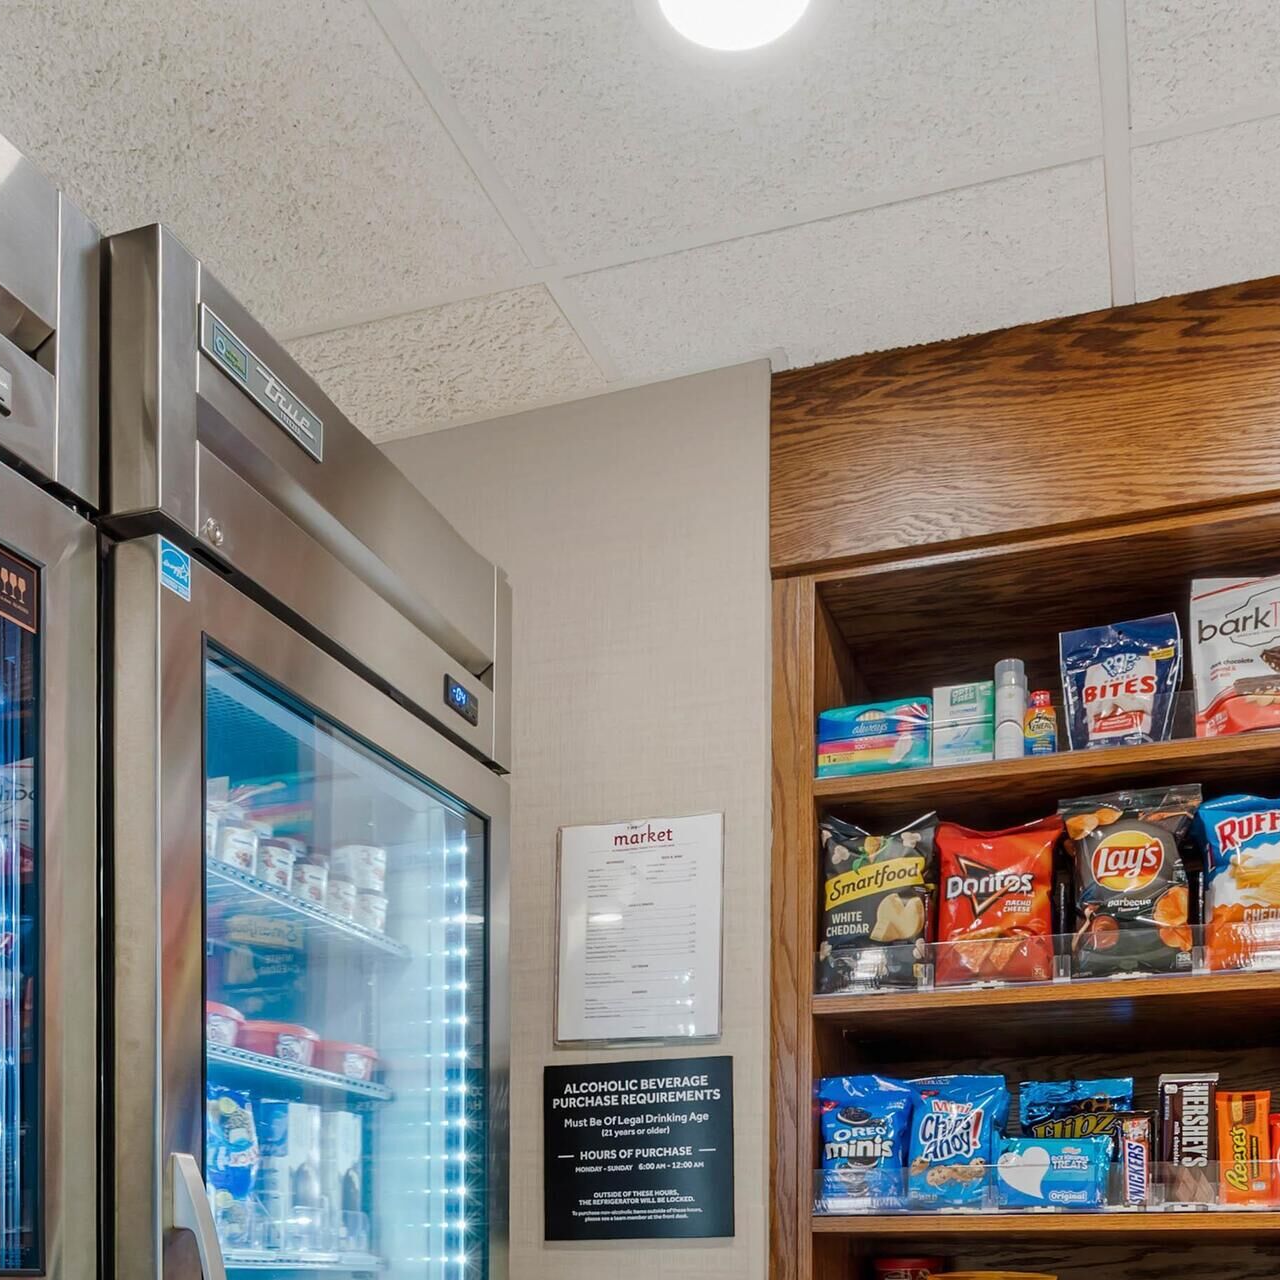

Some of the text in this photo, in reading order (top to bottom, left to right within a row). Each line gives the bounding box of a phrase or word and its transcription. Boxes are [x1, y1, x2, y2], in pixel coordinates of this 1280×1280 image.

[1083, 675, 1157, 704] BITES
[851, 721, 889, 736] always
[613, 824, 674, 847] market
[1096, 844, 1160, 880] Lay's
[829, 862, 919, 902] Smartfood
[945, 872, 1035, 900] Doritos
[1004, 899, 1032, 907] NACHO
[1106, 897, 1152, 908] Barbecue
[831, 910, 863, 924] WHITE
[825, 923, 871, 938] CHEDDAR
[563, 1075, 709, 1095] ALCOHOLIC BEVERAGE
[552, 1088, 721, 1109] PURCHASE REQUIREMENTS
[932, 1098, 974, 1115] Mini
[563, 1111, 710, 1128] Must Be Of Legal Drinking Age
[919, 1112, 972, 1145] Chips
[1033, 1109, 1119, 1139] Flipz
[1181, 1082, 1210, 1168] HERSHEY'S
[601, 1126, 671, 1138] (21 years or older)
[833, 1125, 887, 1142] OREO
[579, 1146, 693, 1161] HOURS OF PURCHASE
[824, 1136, 895, 1161] minis
[575, 1165, 603, 1173] MONDAY
[606, 1164, 633, 1172] SUNDAY
[638, 1162, 656, 1171] 6:00
[671, 1161, 693, 1170] 12:00
[693, 1161, 705, 1169] AM
[1051, 1160, 1090, 1171] TREATS
[1224, 1125, 1249, 1192] Reese's
[1127, 1142, 1146, 1206] SNICKERS
[1050, 1191, 1086, 1202] Original
